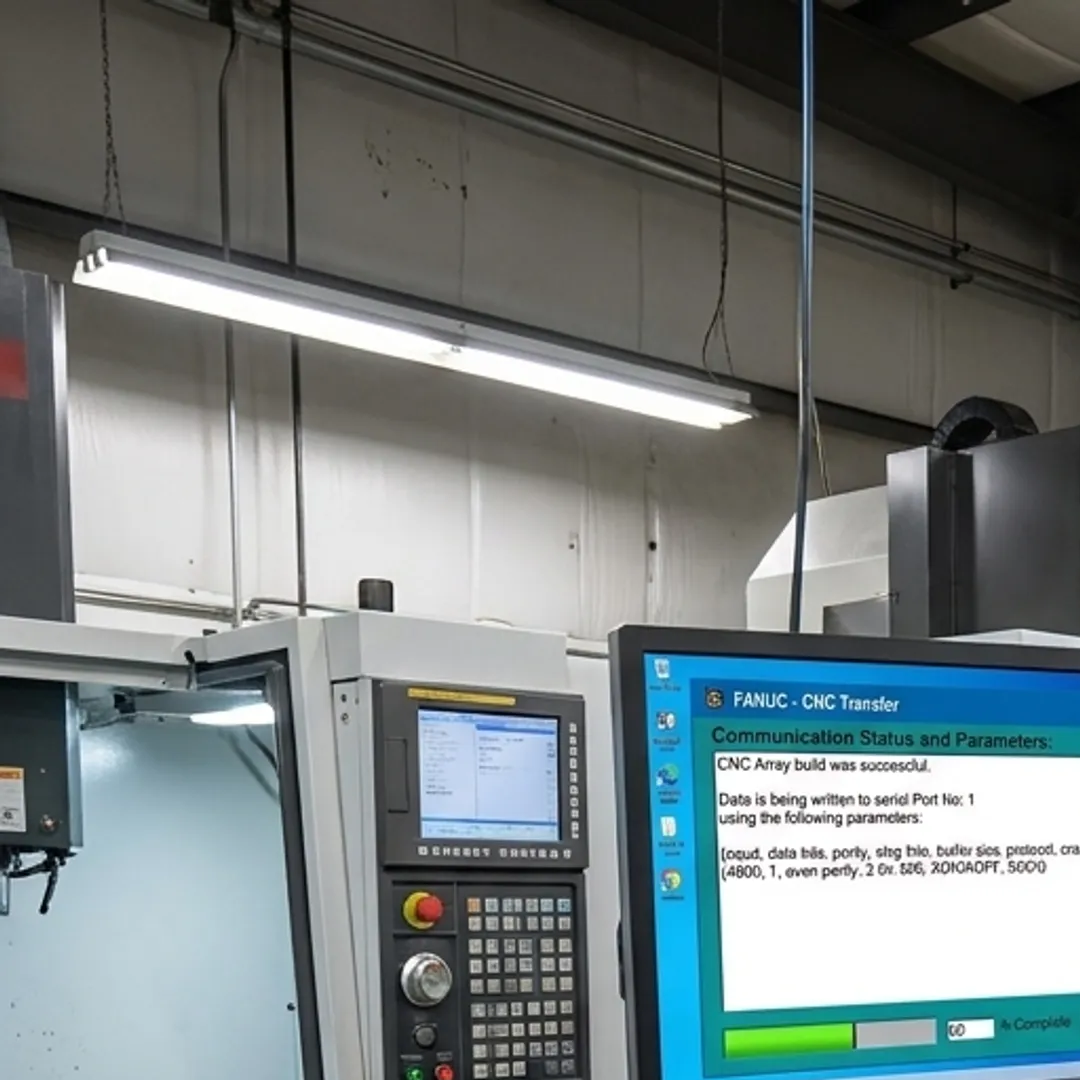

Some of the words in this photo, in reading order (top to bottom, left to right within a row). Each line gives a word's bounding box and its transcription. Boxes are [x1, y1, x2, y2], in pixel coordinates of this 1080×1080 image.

[734, 692, 787, 708] FANUC
[802, 694, 836, 710] CNC
[840, 694, 899, 712] Transfer
[712, 726, 852, 745] Communication
[860, 730, 914, 747] Status
[920, 732, 950, 747] and
[956, 732, 1052, 749] Parameters:
[718, 757, 751, 771] CNC
[754, 758, 791, 775] Array
[829, 761, 856, 771] was
[755, 793, 767, 806] is
[770, 792, 807, 811] being
[858, 794, 871, 806] to
[912, 793, 938, 806] Port
[967, 793, 974, 806] 1
[719, 812, 756, 828] using
[760, 812, 781, 824] the
[785, 810, 843, 828] following
